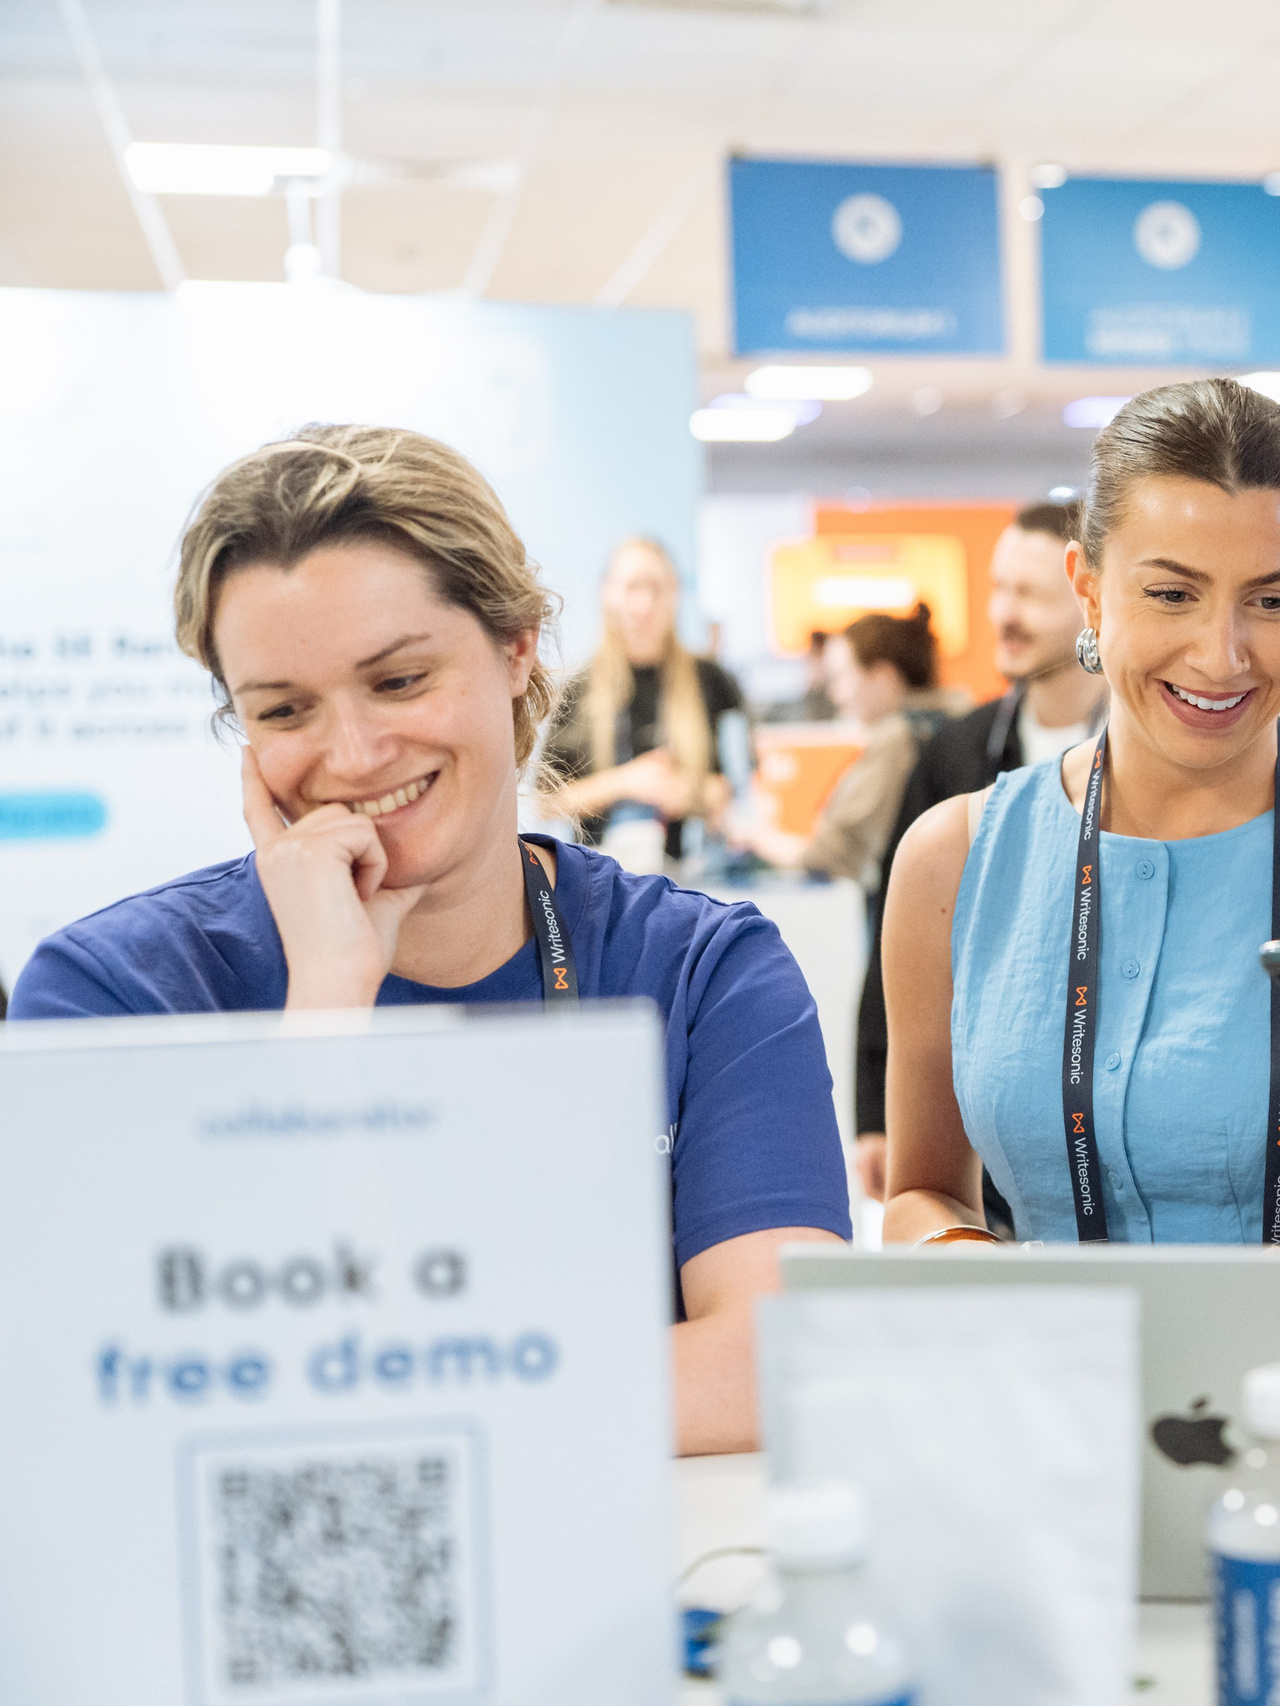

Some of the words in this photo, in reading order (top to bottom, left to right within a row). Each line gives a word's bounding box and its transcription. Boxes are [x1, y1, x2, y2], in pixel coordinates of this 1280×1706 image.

[1083, 769, 1100, 841] Writesonic
[538, 890, 566, 964] Writesonic
[1077, 886, 1092, 961] Writesonic
[1071, 1009, 1087, 1085] Writesonic
[1075, 1137, 1094, 1216] Writesonic
[158, 1237, 381, 1313] Book
[411, 1246, 468, 1299] a
[97, 1337, 271, 1405] free
[306, 1327, 560, 1395] demo
